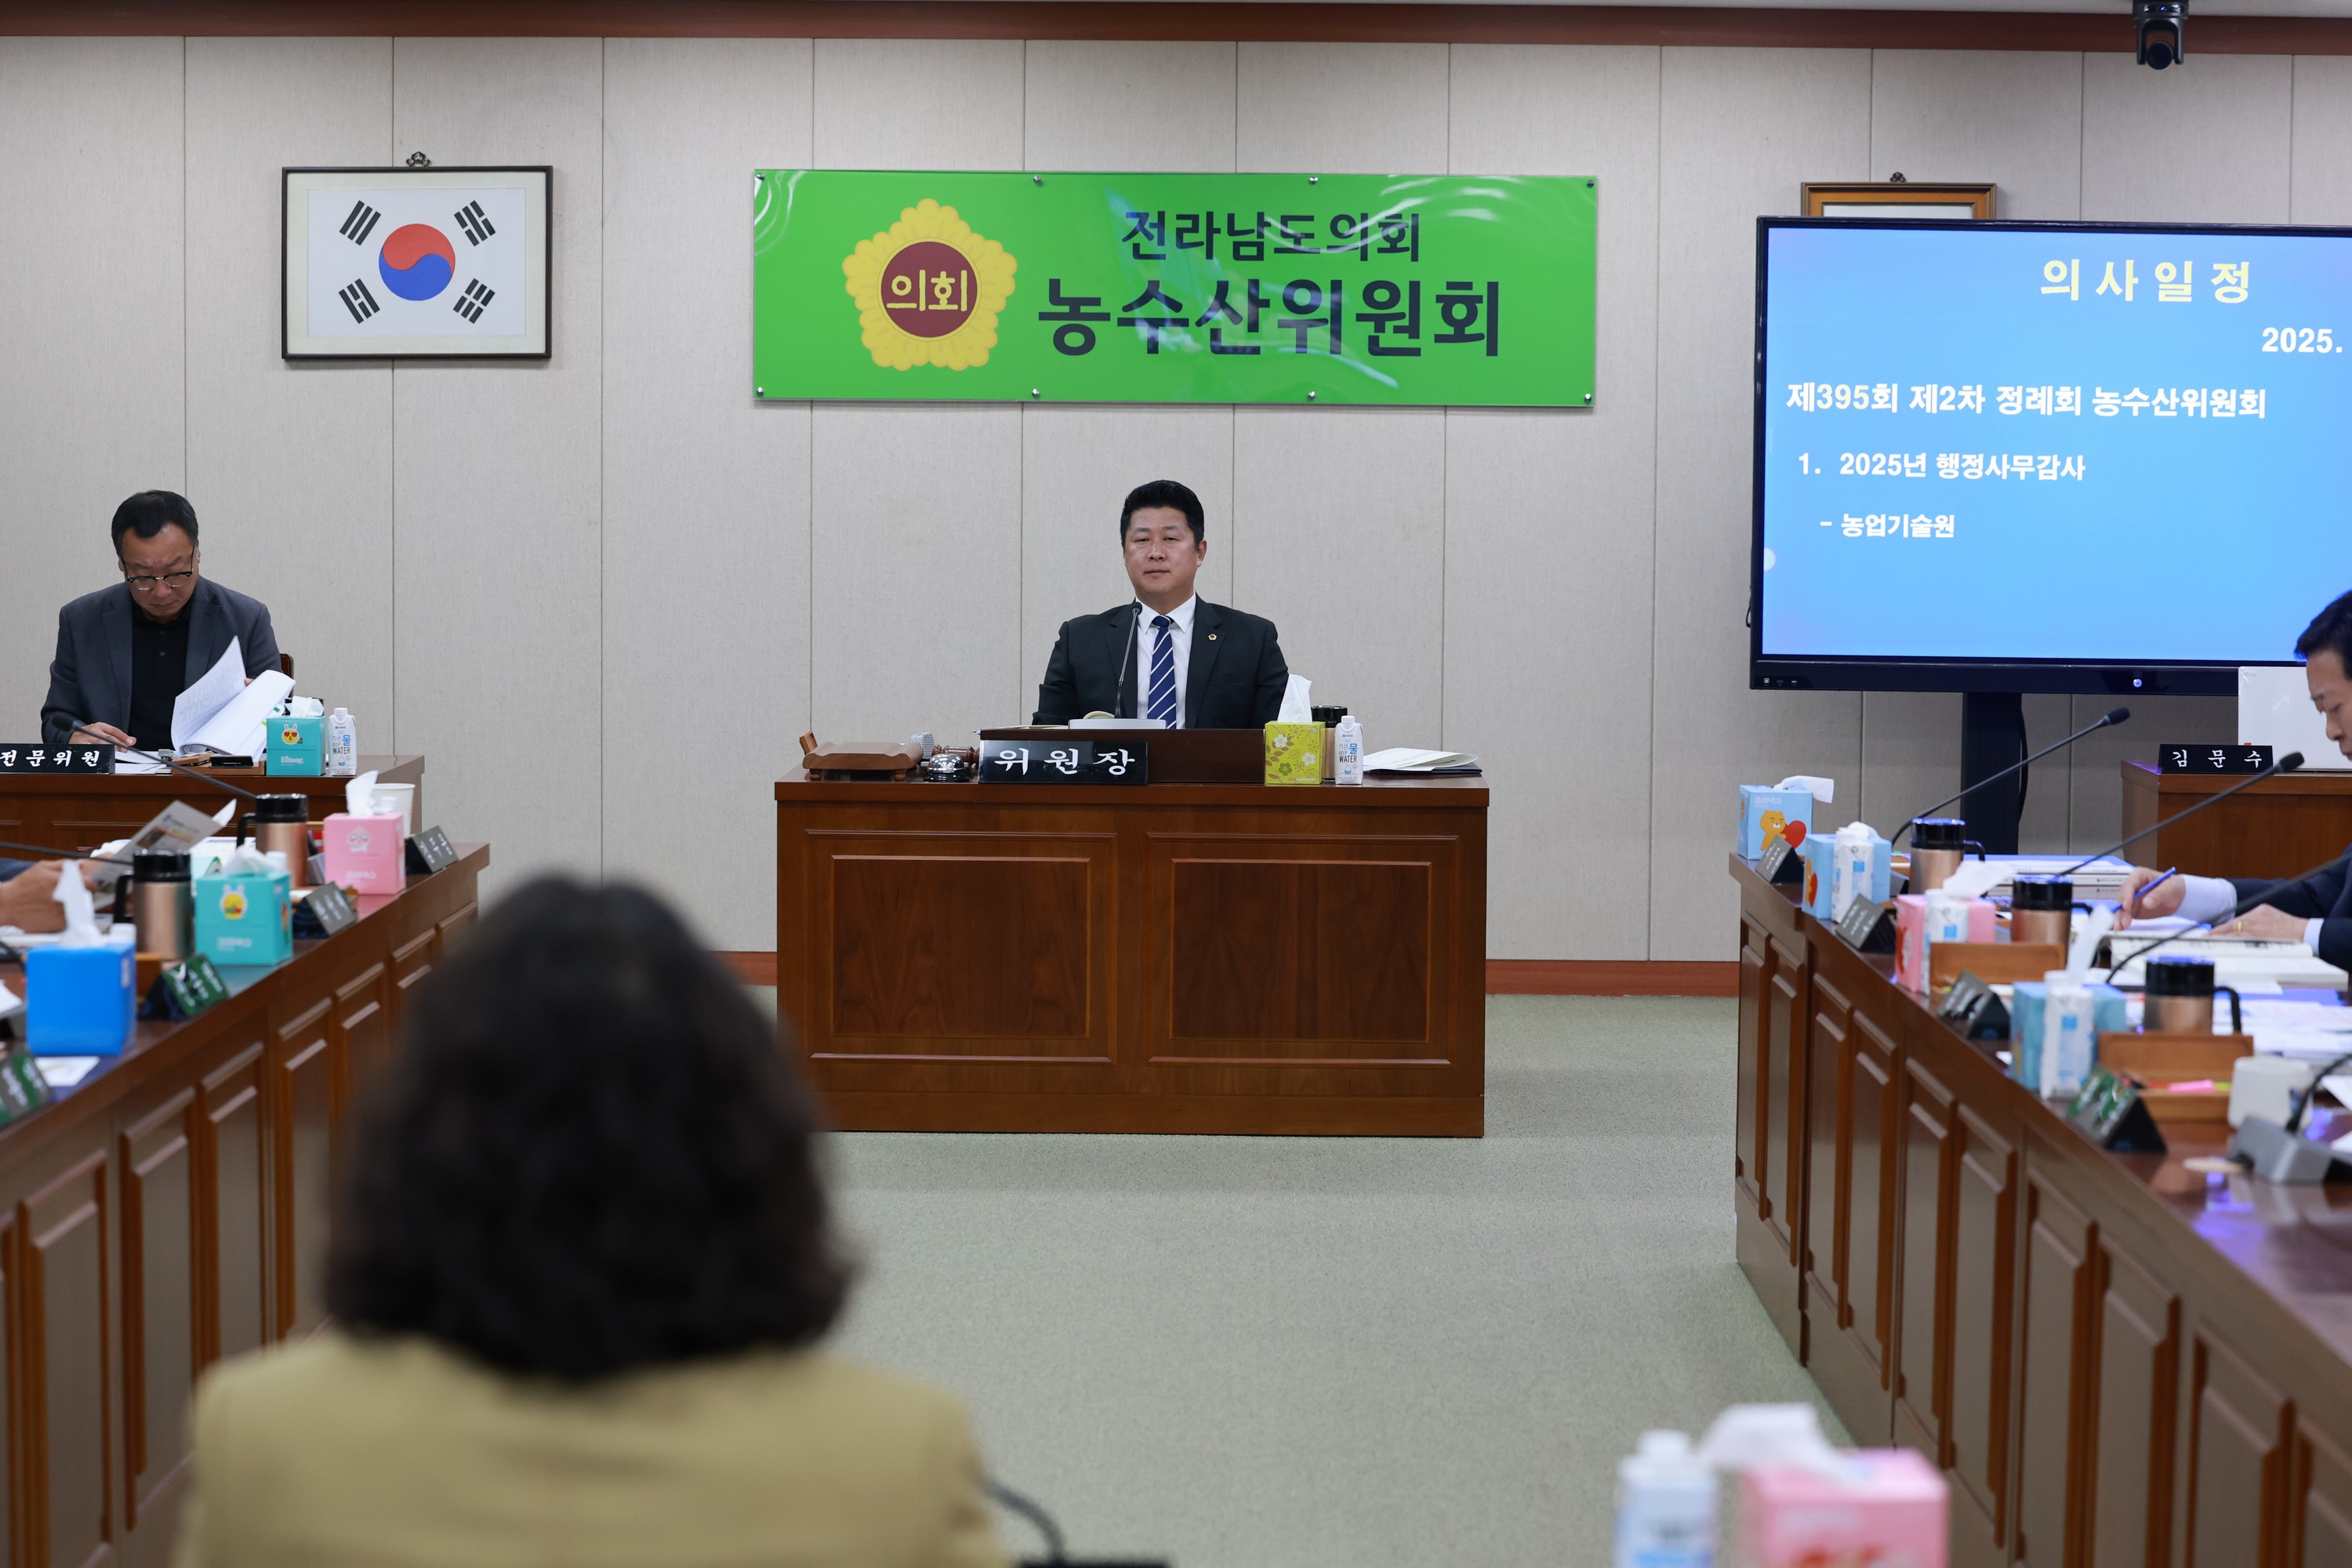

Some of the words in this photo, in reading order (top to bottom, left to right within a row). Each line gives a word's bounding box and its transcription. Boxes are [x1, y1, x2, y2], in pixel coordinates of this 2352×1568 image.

[1122, 210, 1420, 263] 전라남도의회
[886, 268, 969, 313] 의회
[1038, 278, 1499, 358] 농수산위원회
[2262, 327, 2343, 354] 2025.
[1786, 382, 1899, 413] 제395회
[1909, 383, 1986, 414] 제2차
[1996, 385, 2082, 416] 정례회
[2092, 387, 2267, 419] 농수산위원회
[1798, 452, 1821, 475] 1.
[1839, 452, 1927, 478] 2025년
[1936, 452, 2086, 481] 행정사무감사
[1841, 514, 1955, 538] 농업기술원
[0, 750, 100, 768] 전문위원
[993, 747, 1136, 775] 위원장
[2172, 749, 2263, 768] 김문수
